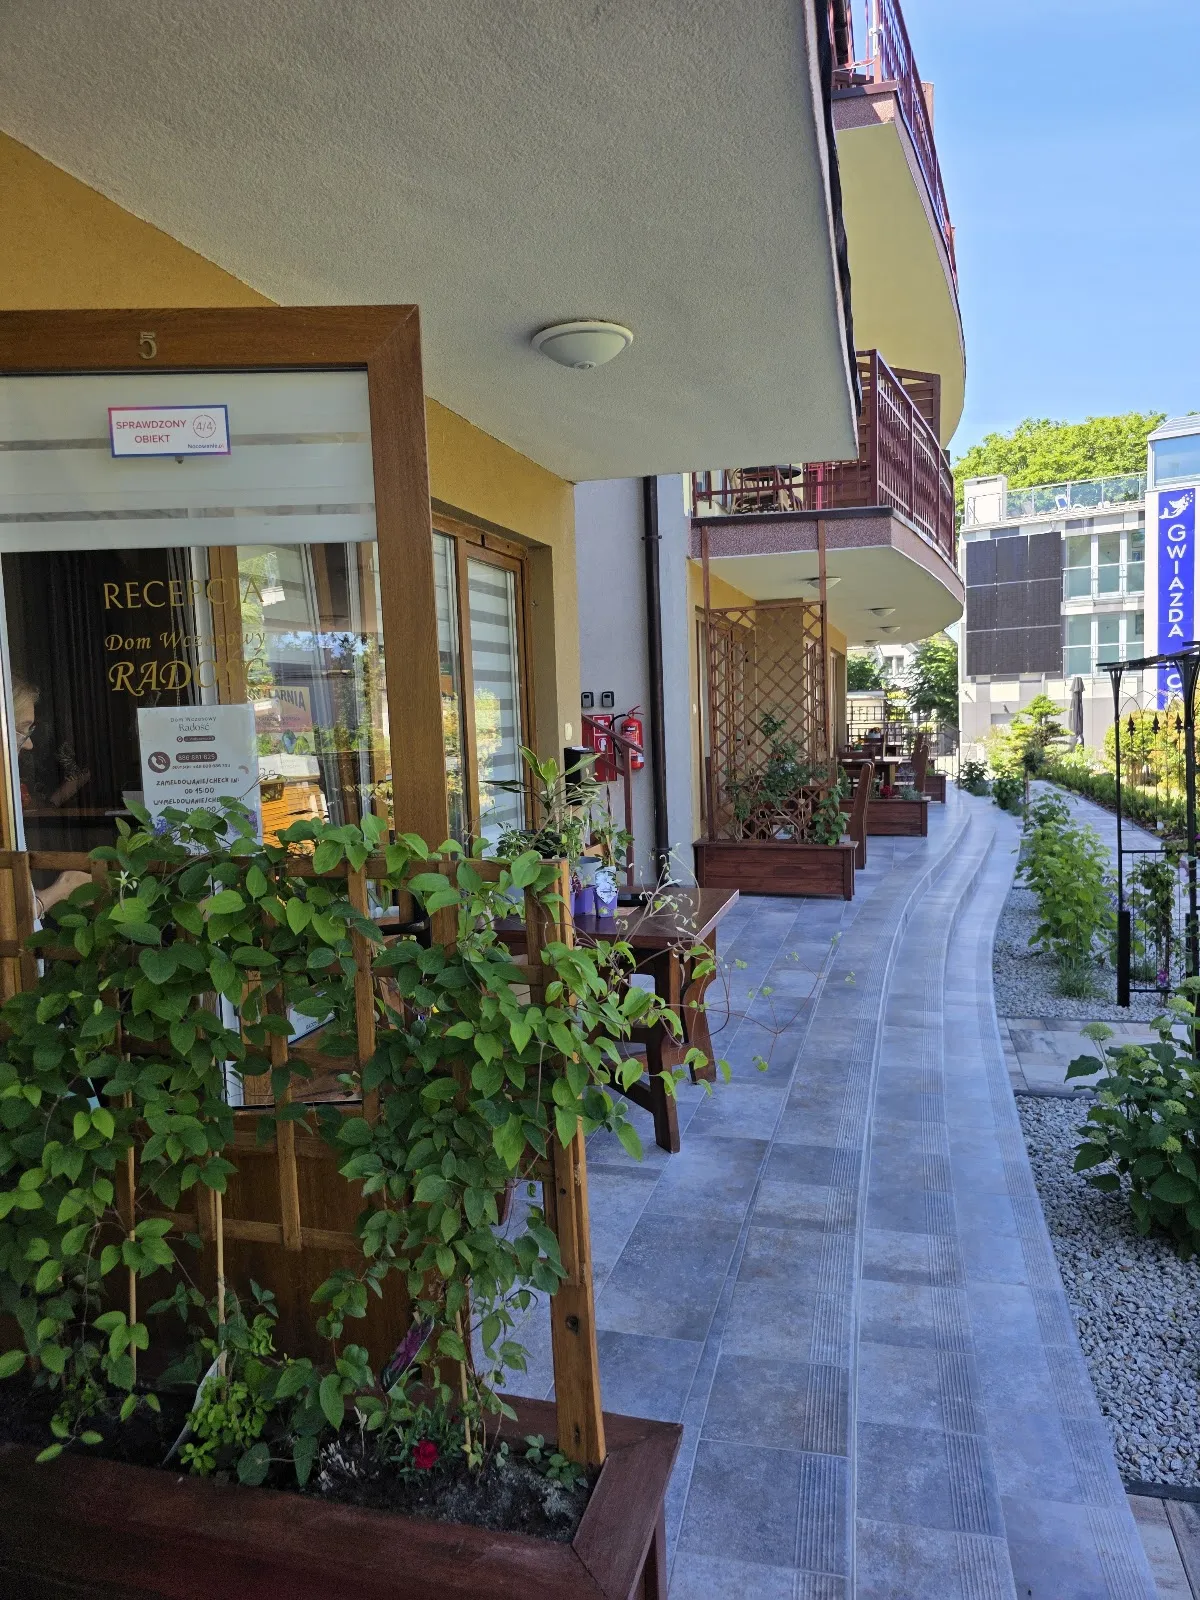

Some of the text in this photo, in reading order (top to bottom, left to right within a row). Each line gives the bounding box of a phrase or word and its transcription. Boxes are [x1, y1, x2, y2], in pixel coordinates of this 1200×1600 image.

[139, 331, 158, 360] 5
[116, 419, 187, 430] SPRAWDZONY
[196, 421, 213, 432] 4/4
[134, 434, 171, 444] OBIEKT
[1167, 523, 1187, 638] GWIAZDA
[103, 576, 264, 610] RECEPCJA
[105, 634, 151, 652] Dom
[178, 722, 210, 732] Radość
[156, 777, 229, 786] ZAMELDOWANIE/CHECK
[153, 797, 220, 806] WYMELDOWANIE/CHE
